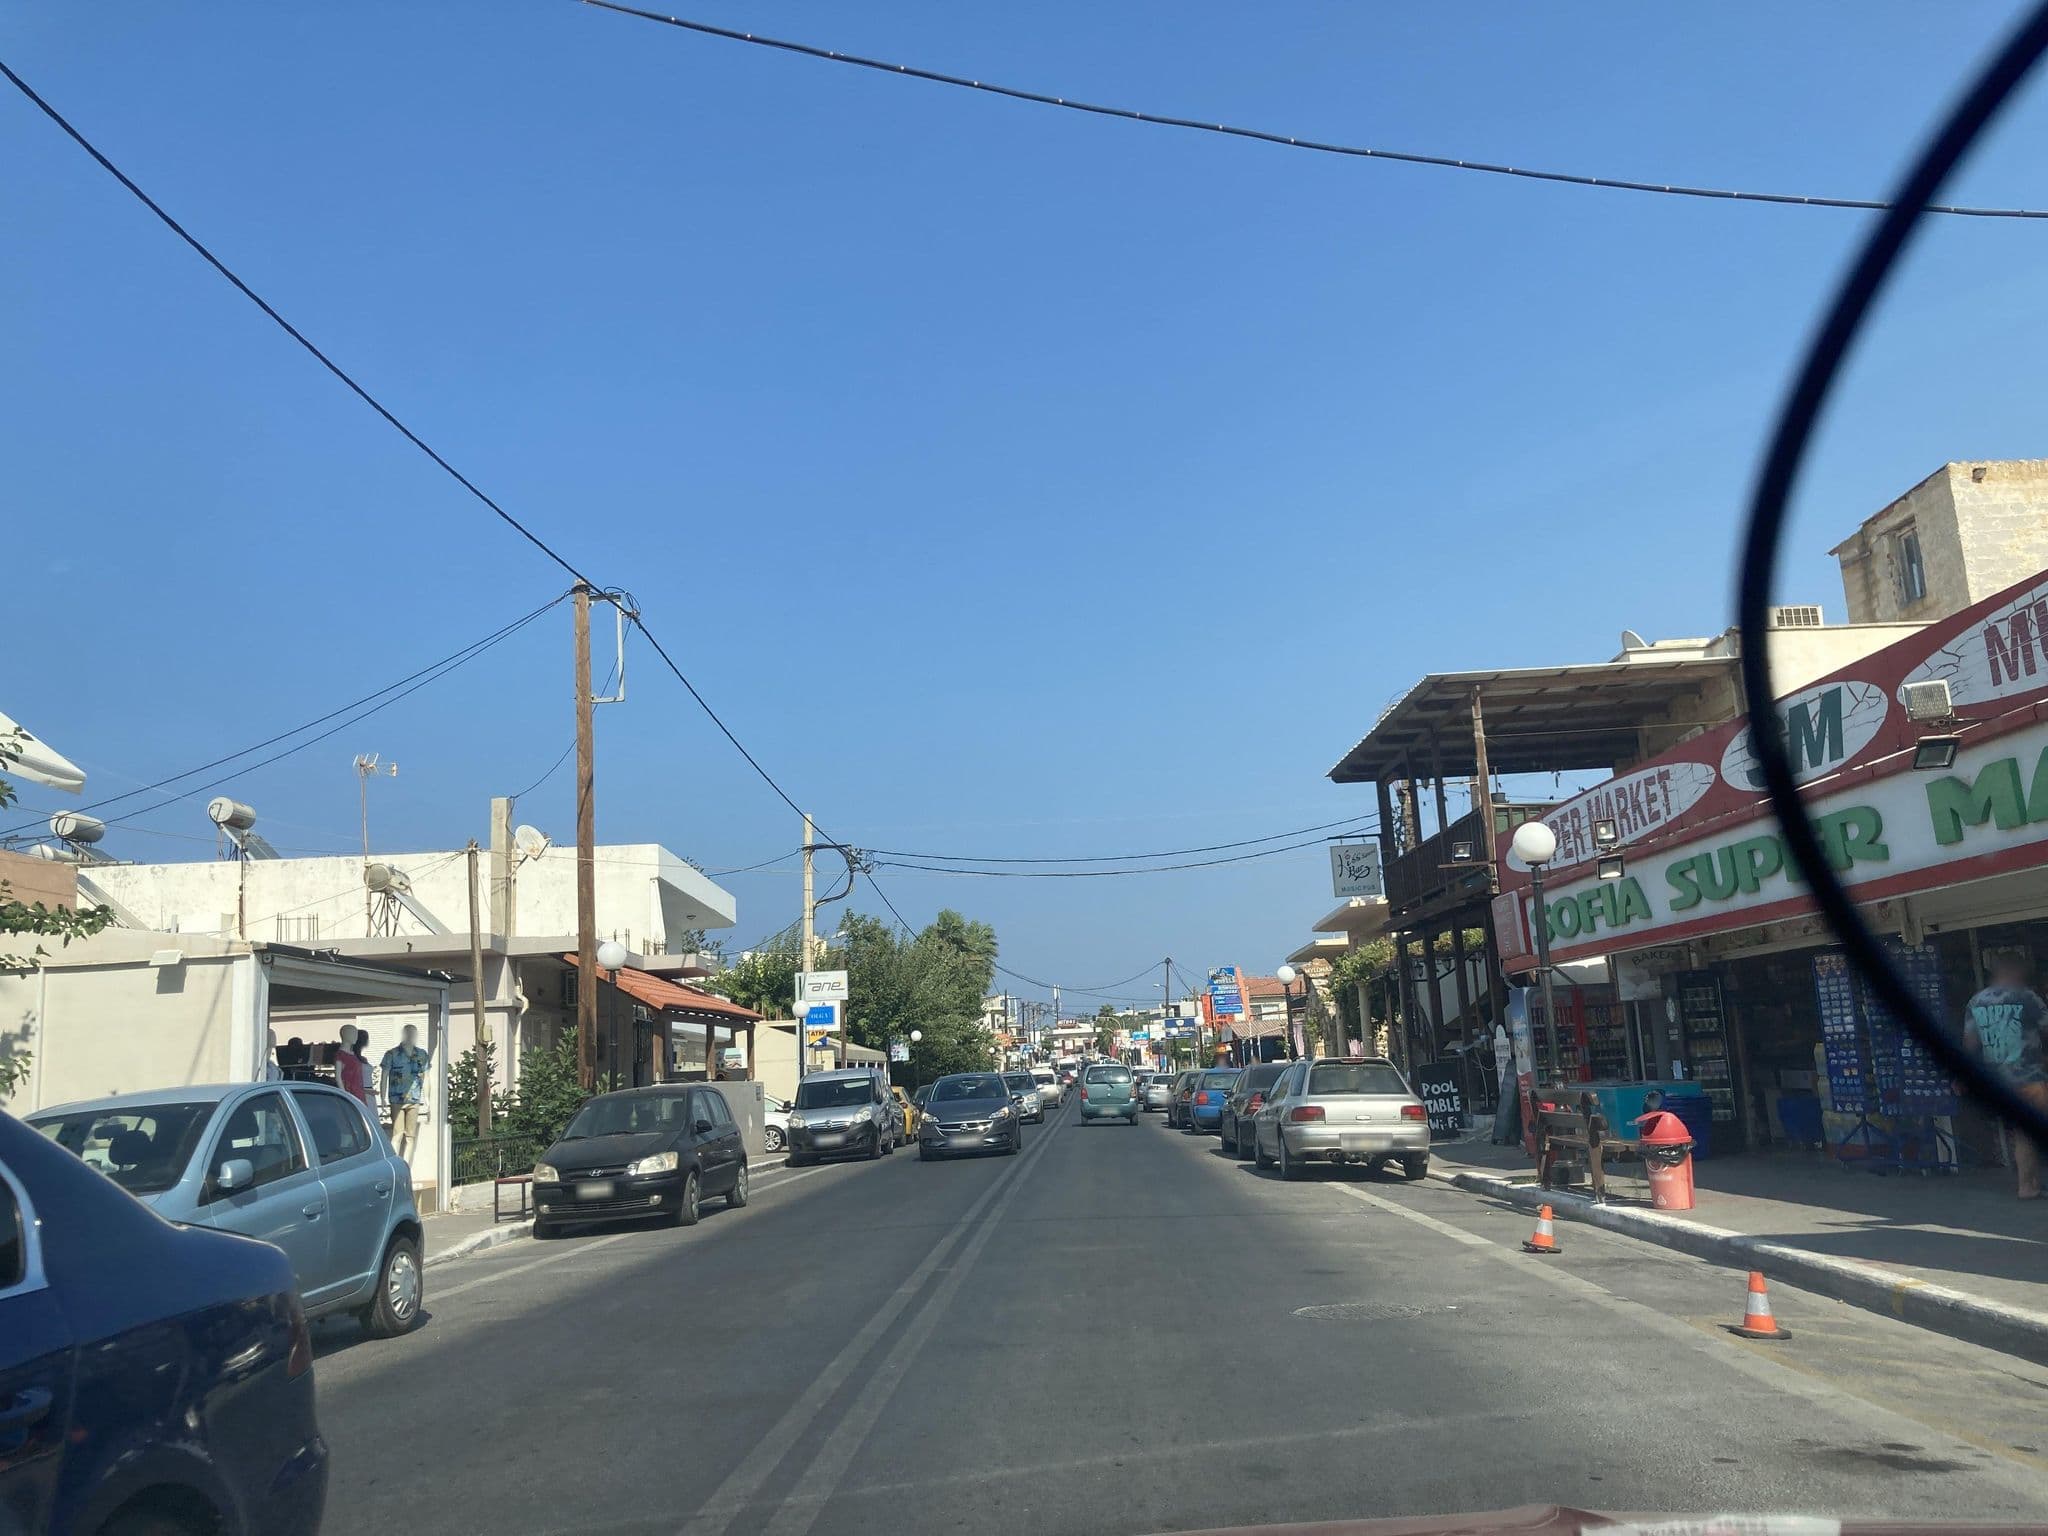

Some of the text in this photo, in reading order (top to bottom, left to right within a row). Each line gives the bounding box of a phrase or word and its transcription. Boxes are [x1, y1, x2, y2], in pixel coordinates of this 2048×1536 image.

[1549, 768, 1672, 862] PER MARKET
[1530, 876, 1653, 946] SOFIA
[1421, 1080, 1458, 1096] POOL
[1424, 1095, 1461, 1114] TABLE
